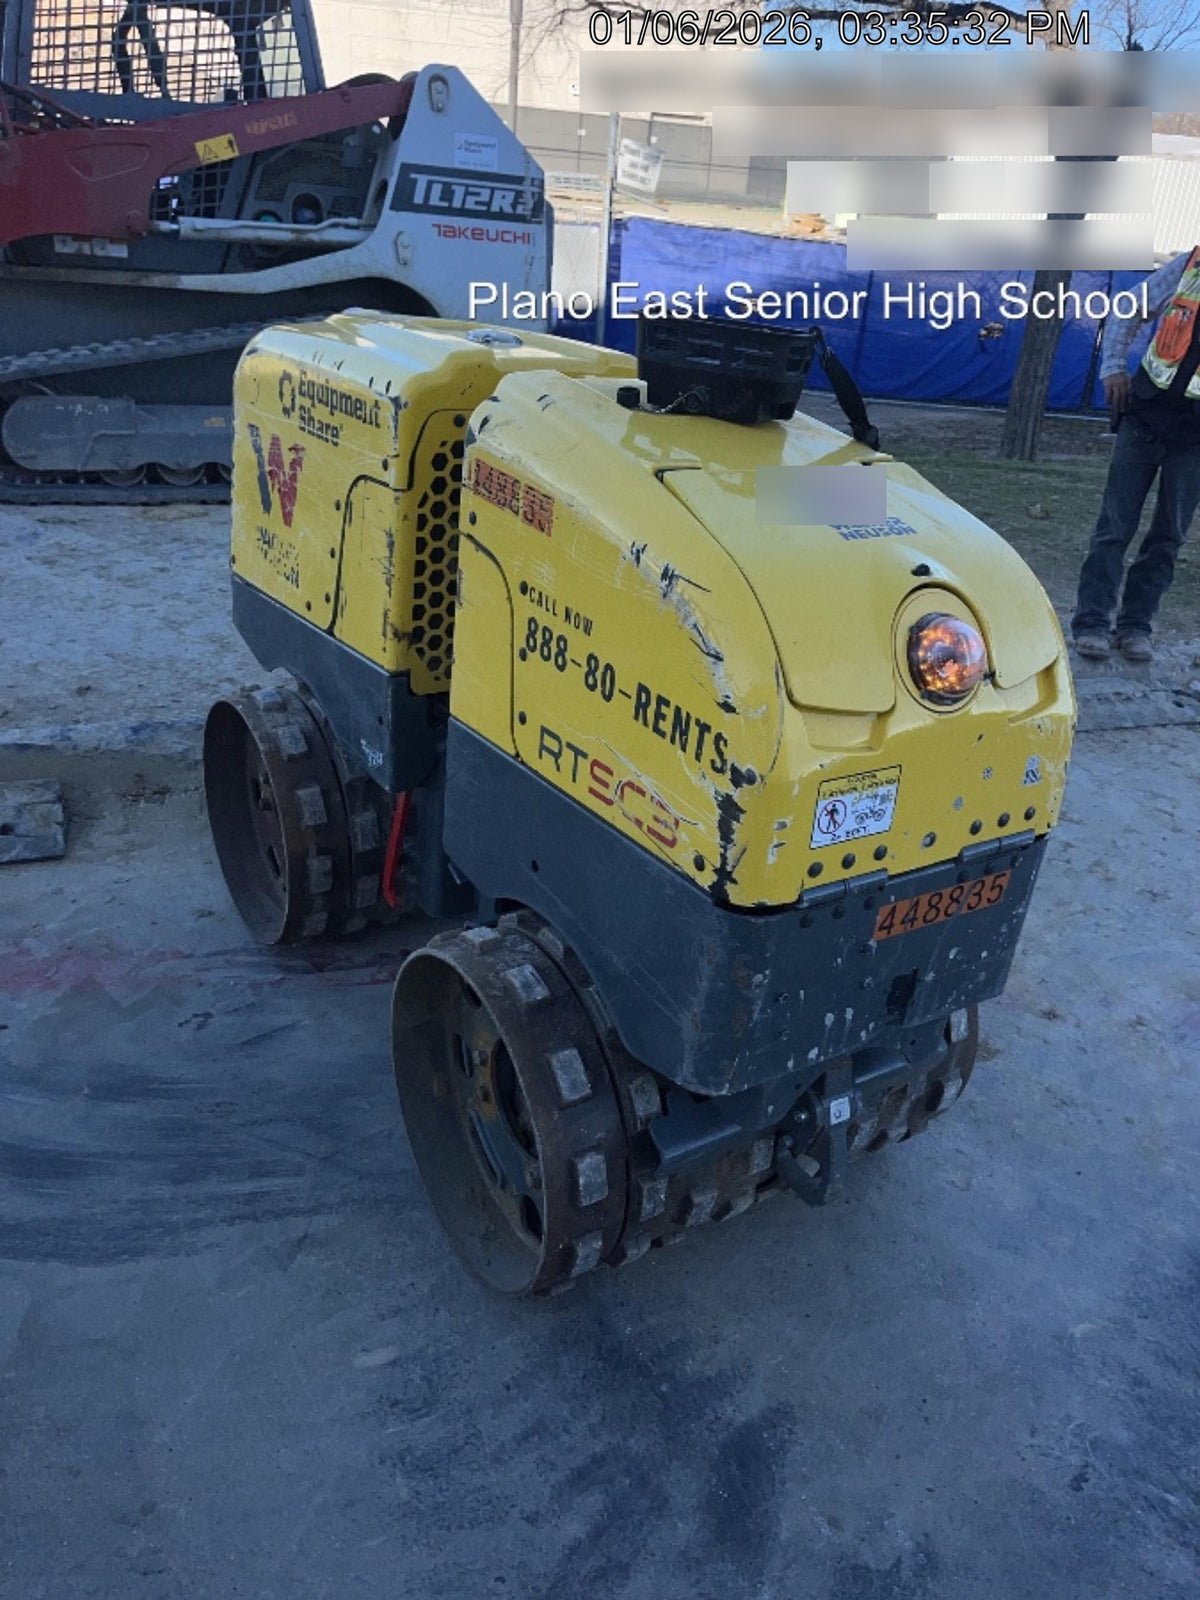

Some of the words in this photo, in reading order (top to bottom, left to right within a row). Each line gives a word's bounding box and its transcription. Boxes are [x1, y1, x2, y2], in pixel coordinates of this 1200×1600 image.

[529, 586, 558, 616] CALL
[564, 606, 594, 637] NOW
[525, 616, 729, 775] 888-80-RENTS
[877, 871, 1007, 936] 448835
